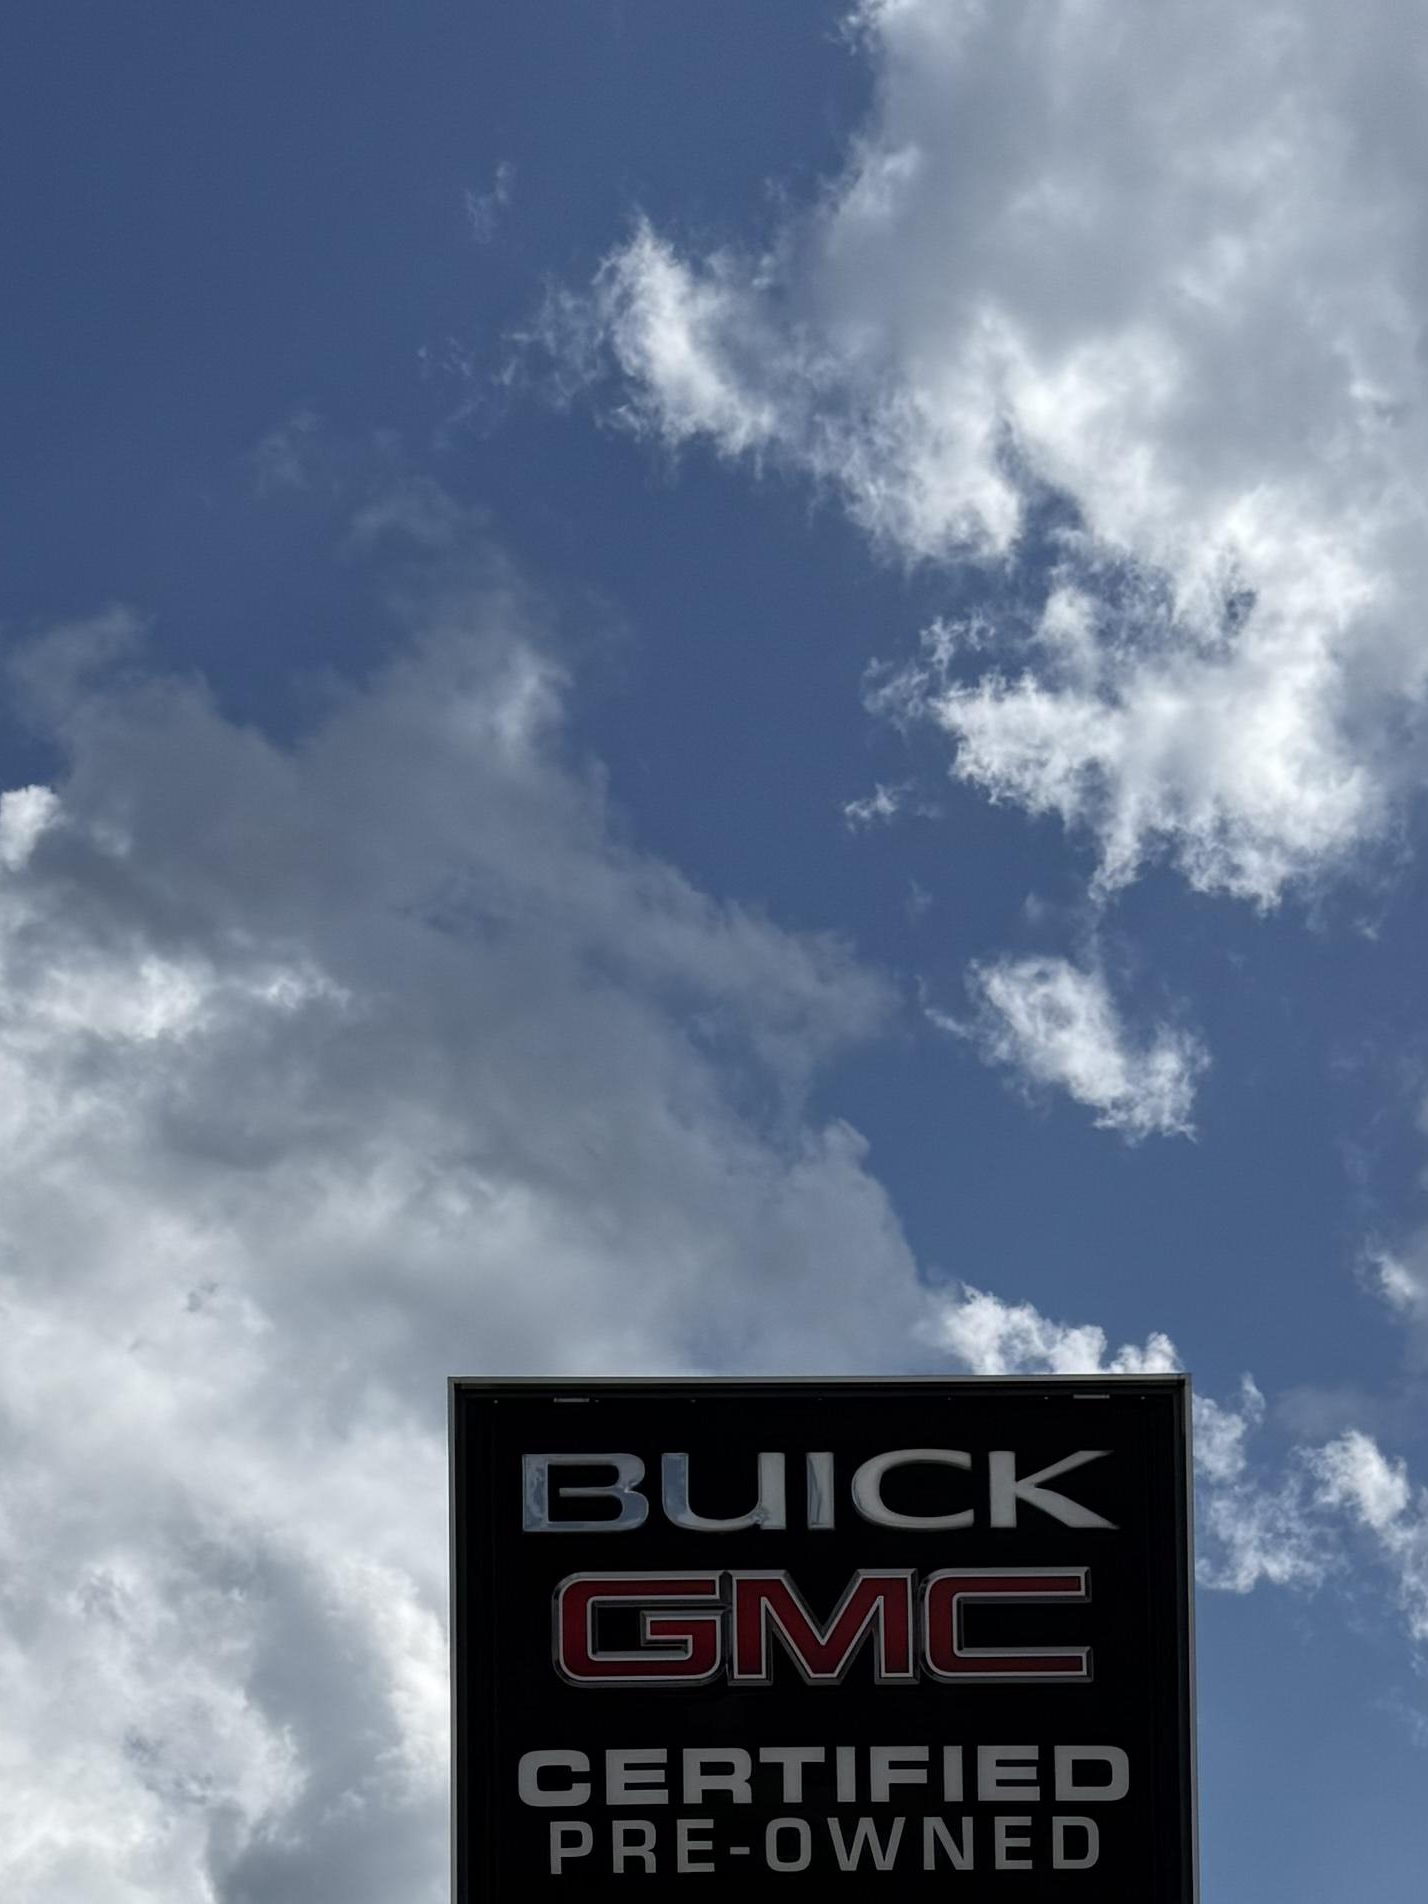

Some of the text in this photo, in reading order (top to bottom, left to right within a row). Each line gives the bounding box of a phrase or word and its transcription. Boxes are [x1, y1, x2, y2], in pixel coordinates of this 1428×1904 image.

[521, 1448, 1121, 1532] BUICK
[551, 1566, 1094, 1688] GMC
[517, 1744, 1131, 1808] CERTIFIED
[549, 1815, 1101, 1875] PRE-OWNED
